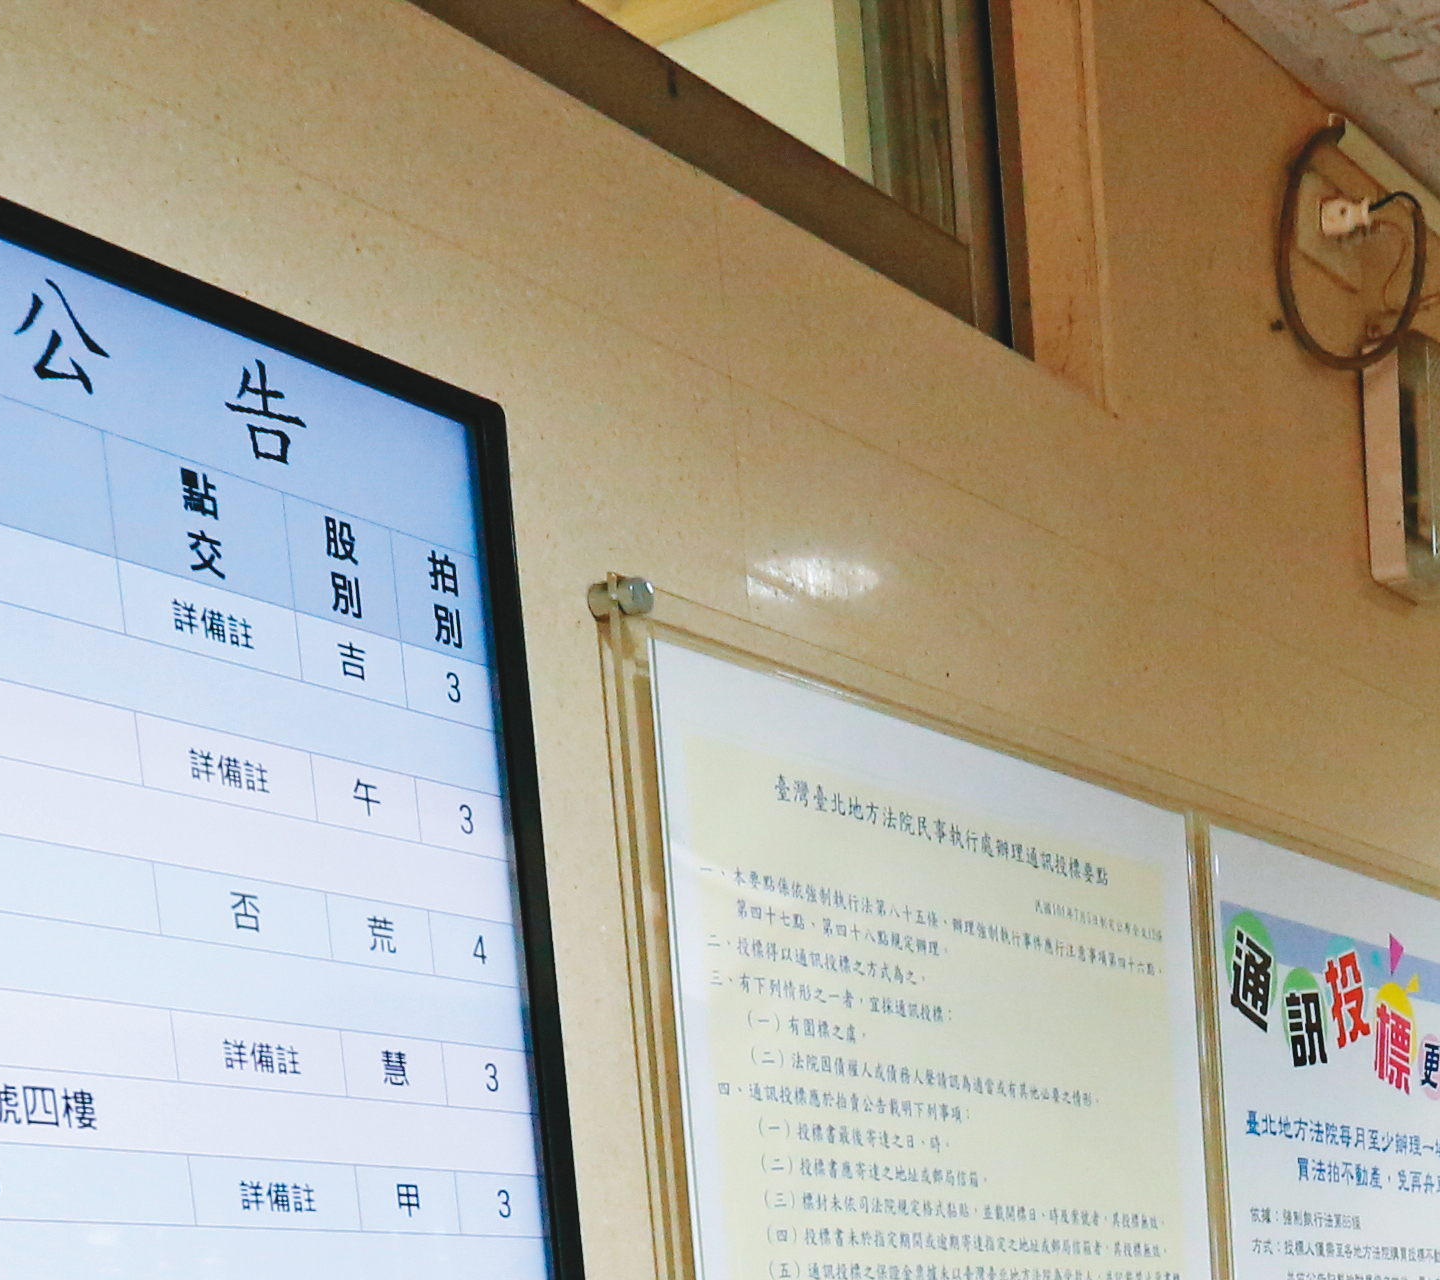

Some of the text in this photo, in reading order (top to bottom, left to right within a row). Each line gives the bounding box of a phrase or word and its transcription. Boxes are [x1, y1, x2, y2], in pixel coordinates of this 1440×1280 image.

[179, 467, 226, 581] 點交
[323, 516, 364, 620] 股別
[428, 549, 464, 650] 拍別
[171, 599, 255, 652] 詳備註
[337, 642, 367, 682] 吉
[445, 672, 463, 704] 3
[188, 749, 270, 796] 詳備註
[351, 776, 382, 818] 午
[458, 804, 476, 837] 3
[229, 890, 263, 935] 否
[367, 914, 398, 955] 荒
[471, 935, 489, 967] 4
[222, 1037, 302, 1078] 詳備註
[379, 1047, 412, 1091] 慧
[484, 1062, 500, 1094] 3
[238, 1179, 318, 1215] 詳備註
[396, 1182, 422, 1217] 甲
[496, 1189, 512, 1219] 3
